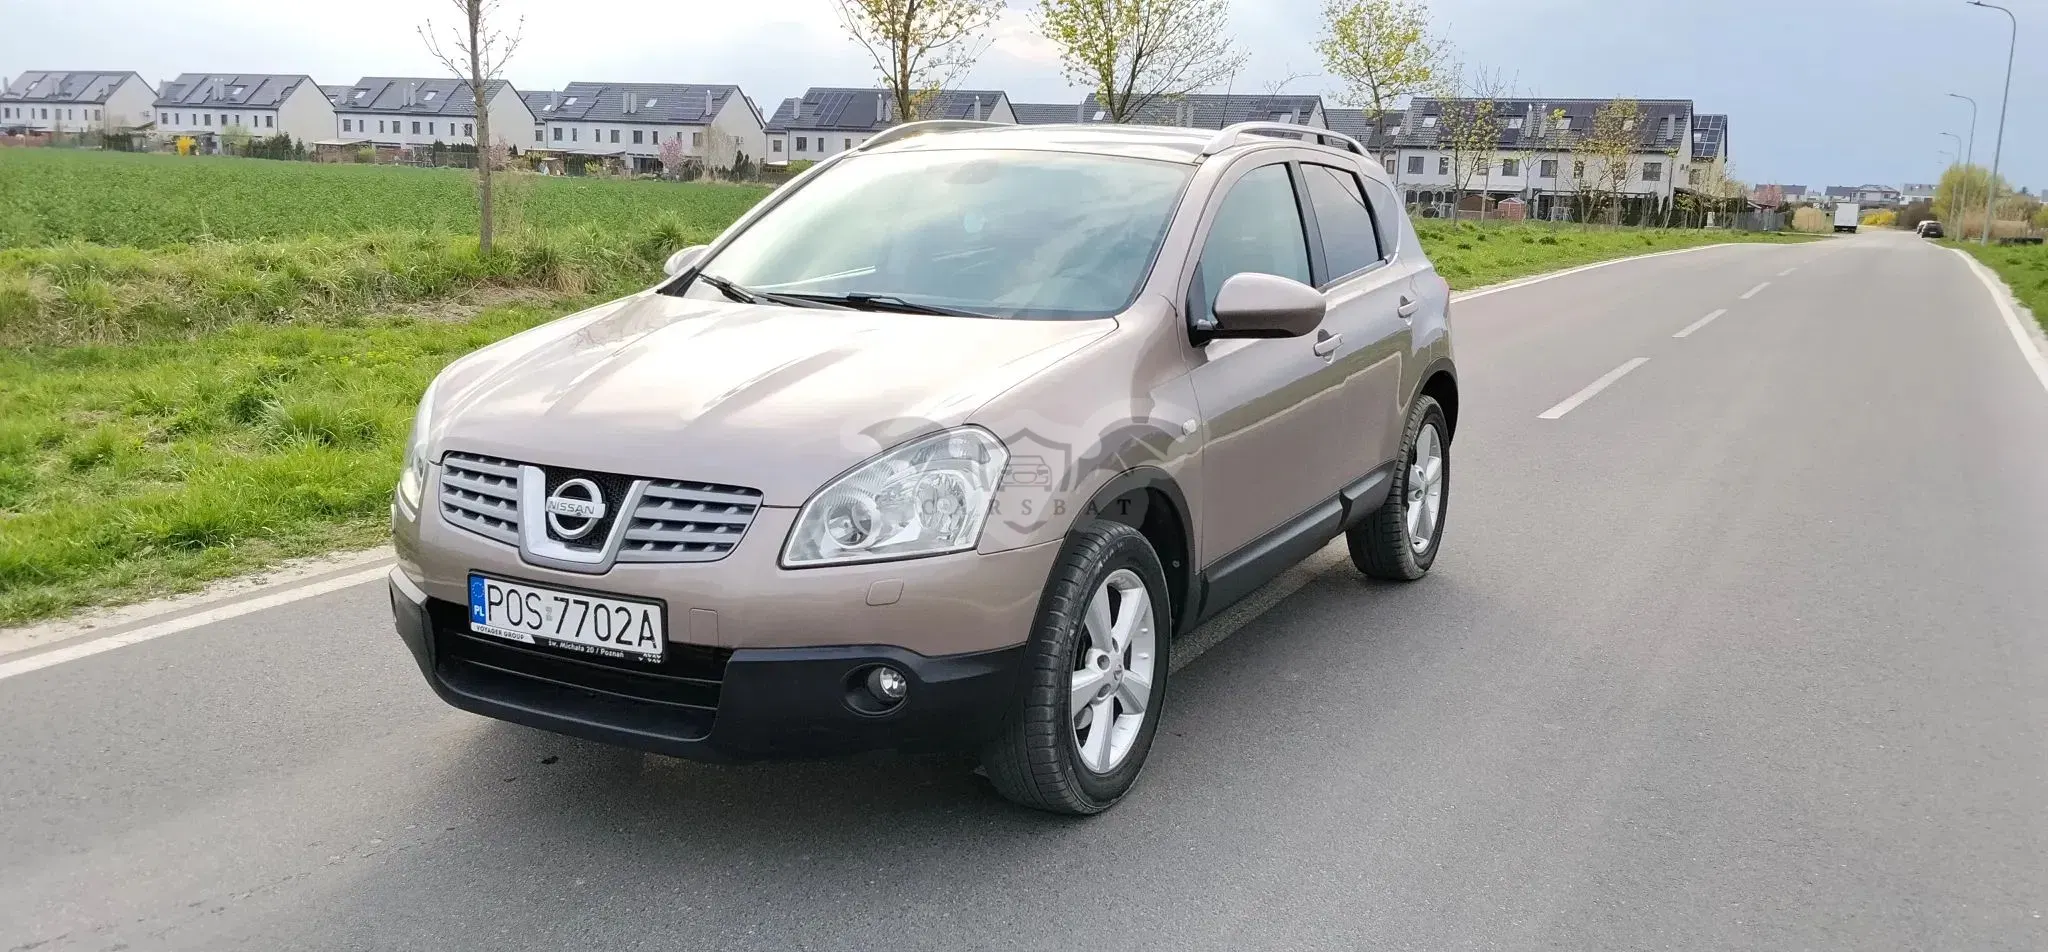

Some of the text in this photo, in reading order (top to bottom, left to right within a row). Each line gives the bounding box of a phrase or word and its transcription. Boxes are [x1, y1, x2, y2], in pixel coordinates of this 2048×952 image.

[547, 500, 595, 516] NISSAN
[474, 605, 485, 617] PL
[487, 584, 657, 649] POS 7702A
[476, 625, 525, 640] VOYAGER GROUP
[585, 646, 595, 654] 20
[600, 648, 625, 658] Poznań
